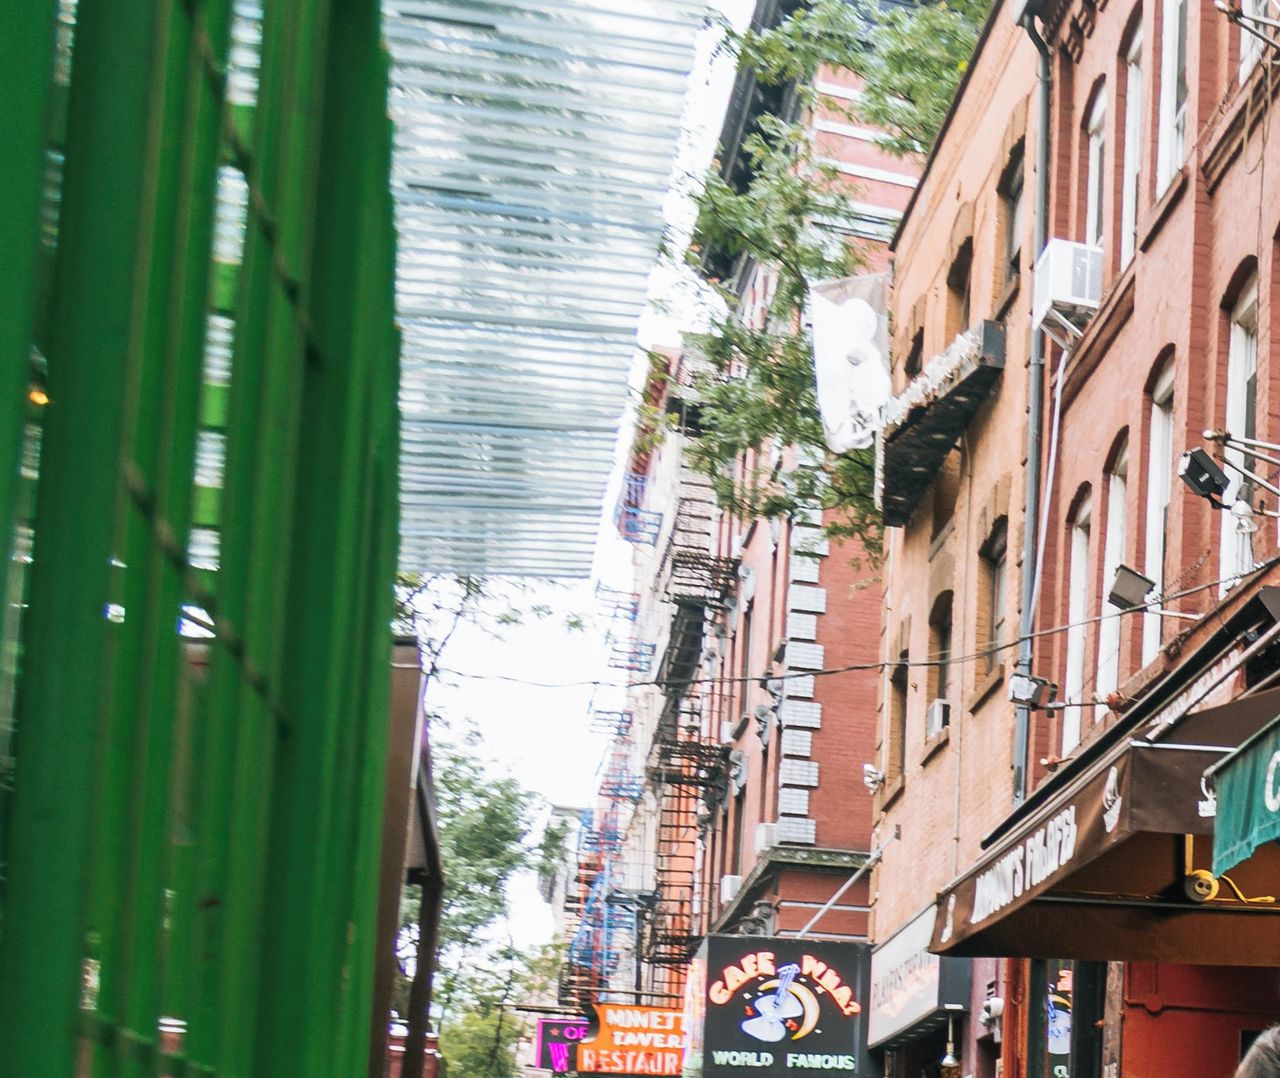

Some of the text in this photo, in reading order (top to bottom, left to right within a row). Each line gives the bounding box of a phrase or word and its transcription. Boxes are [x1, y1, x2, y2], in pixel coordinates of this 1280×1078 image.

[709, 951, 776, 1005] CAFE
[801, 954, 862, 1017] WHA?
[605, 1008, 688, 1030] MINETT
[612, 1031, 687, 1048] TAVER
[582, 1048, 680, 1074] RESTAUR
[712, 1050, 855, 1070] WORLD FAMOUS
